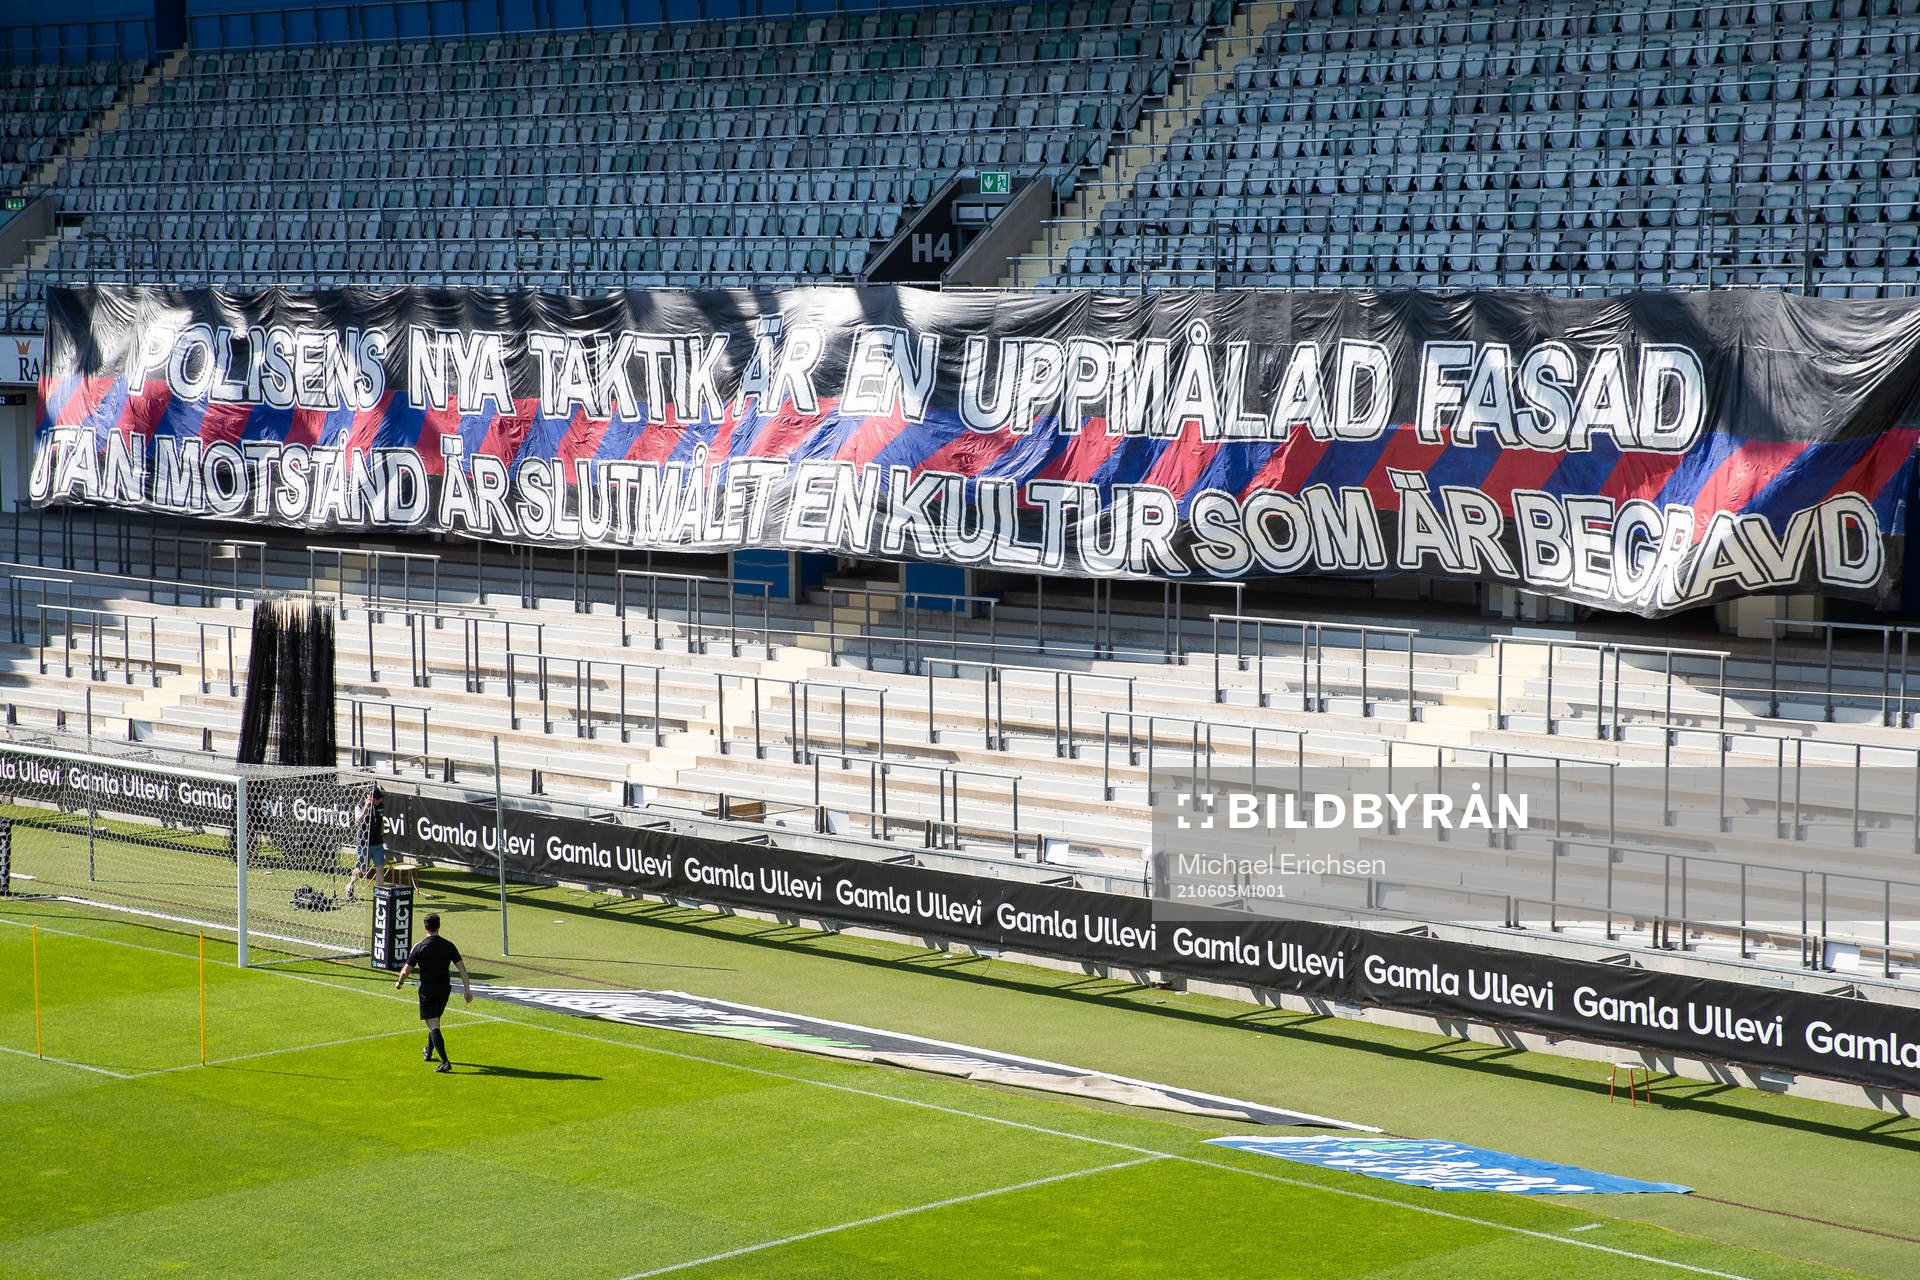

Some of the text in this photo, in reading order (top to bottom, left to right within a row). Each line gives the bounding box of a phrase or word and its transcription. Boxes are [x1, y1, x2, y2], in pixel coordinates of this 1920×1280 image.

[912, 233, 952, 263] H4
[128, 312, 1706, 454] POLISENS NYA TAKTIK ÄR EN UPPMÅLAD FASAD
[30, 426, 1886, 610] UTAN MOTSTÅND ÄR SLUTMÅLET EN KULTUR SOM ÄR BEGRAVD
[18, 759, 61, 787] Ullevi
[122, 774, 169, 801] Ullevi
[178, 782, 232, 810] Gamla
[293, 798, 350, 828] Gamla
[417, 816, 477, 848] Gamla
[546, 835, 673, 879] Gamla Ullevi
[684, 857, 822, 901] Gamla Ullevi
[835, 879, 983, 926] Gamla Ullevi
[996, 902, 1157, 951] Gamla Ullevi
[374, 898, 387, 960] SELECT
[395, 899, 410, 960] SELECT
[1172, 927, 1345, 980] Gamla Ullevi
[1364, 954, 1554, 1011] Gamla Ullevi
[1573, 986, 1783, 1047] Gamla Ullevi
[1805, 1020, 1920, 1069] Gamla
